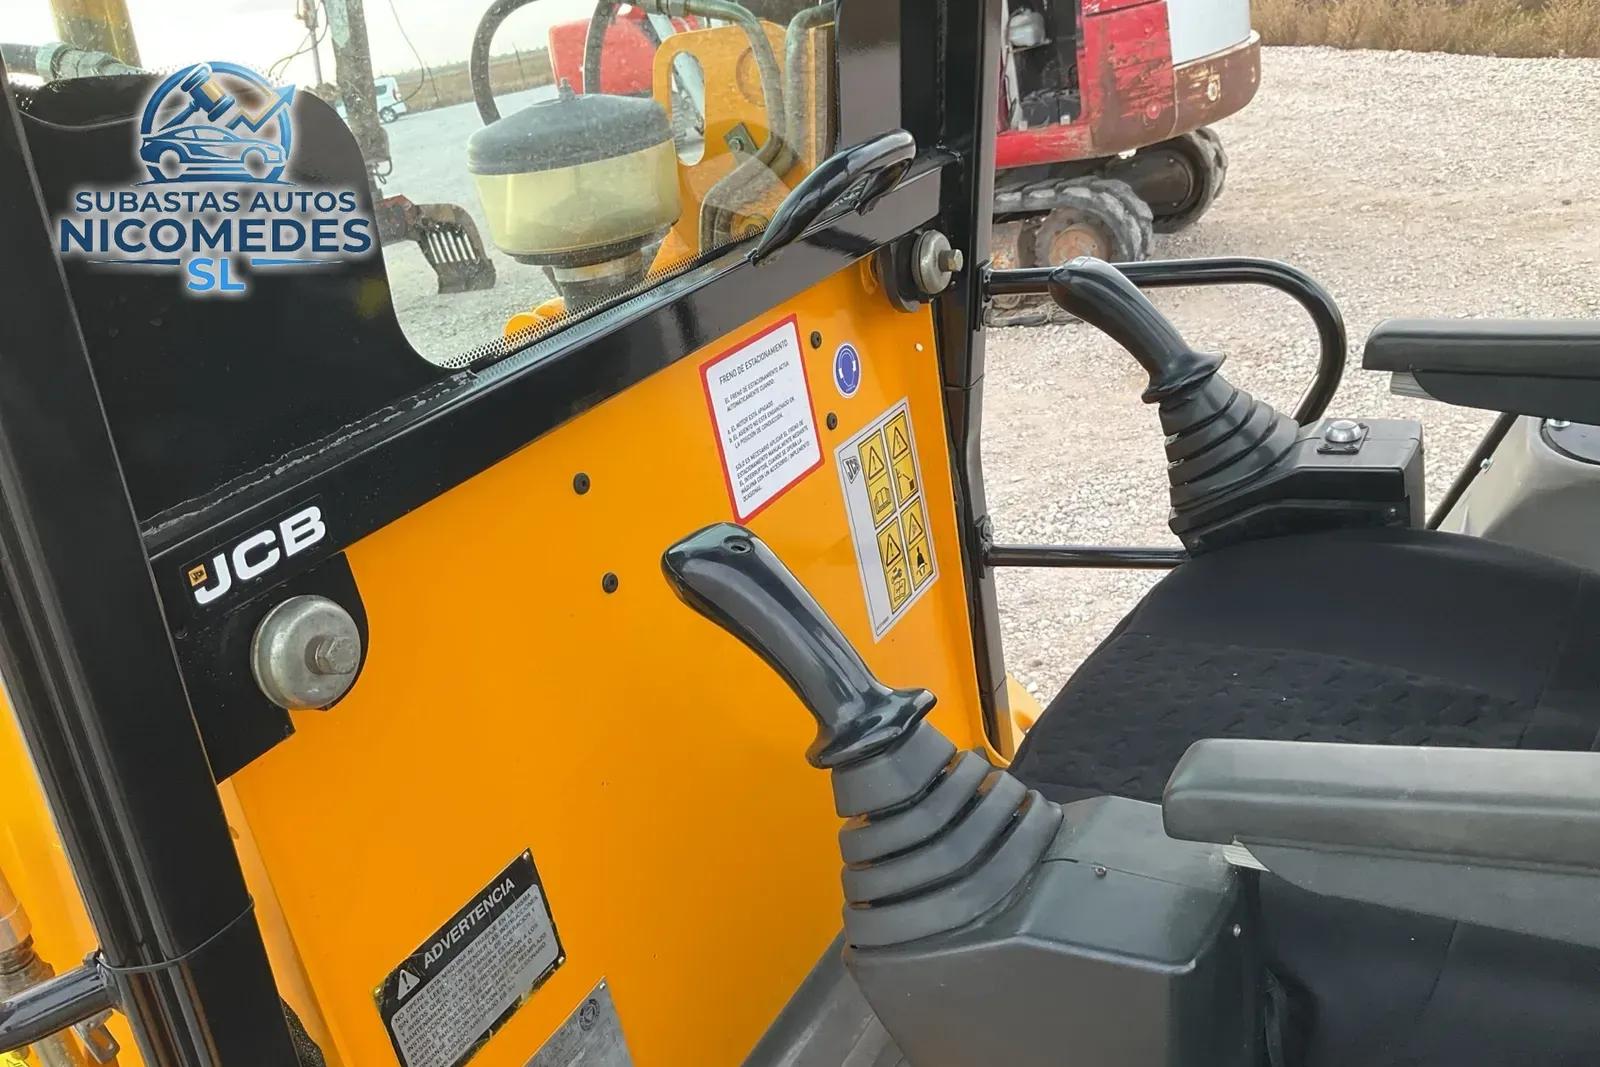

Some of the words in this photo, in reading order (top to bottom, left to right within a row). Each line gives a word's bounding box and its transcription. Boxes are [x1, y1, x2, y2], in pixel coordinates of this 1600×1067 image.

[719, 369, 737, 385] FRENO
[737, 364, 745, 375] DE
[745, 339, 788, 370] ESTACIONAMIENTO
[730, 389, 742, 400] FRENO
[748, 367, 778, 390] ESTACIONAMIENTO
[736, 417, 748, 428] MOTOR
[739, 424, 753, 437] ASIENTO
[737, 453, 768, 479] ESTACIONAMIENTO
[768, 436, 792, 456] MANUALMENTE
[750, 443, 769, 460] NECESARIO
[770, 434, 783, 446] APLICAR
[788, 423, 799, 432] FRENO
[768, 452, 781, 465] CUANDO
[787, 442, 797, 452] OPERA
[844, 459, 860, 480] JCB
[194, 506, 326, 605] JCB
[425, 878, 515, 969] ADVERTENCIA
[395, 1012, 404, 1023] NO
[406, 993, 424, 1013] OPERE
[426, 979, 441, 994] ESTA
[498, 917, 506, 926] EN
[507, 909, 514, 918] LA
[514, 893, 531, 910] MISMA
[398, 1018, 409, 1030] SIN
[410, 1000, 429, 1020] ANTES
[429, 984, 445, 1000] LEER
[451, 943, 487, 980] COMPRENDER
[488, 933, 499, 945] LAS
[499, 895, 538, 934] INSTRUCCIONES
[458, 982, 467, 993] NO
[469, 974, 476, 983] SE
[477, 953, 497, 975] SIGUEN
[498, 937, 513, 955] ESTAS
[491, 968, 502, 980] SER
[407, 1007, 452, 1053] INSTRUCCIONES
[459, 992, 468, 1002] NO
[469, 983, 476, 992] SE
[478, 964, 497, 984] PRESTA
[528, 923, 538, 935] LOS
[408, 1010, 428, 1031] AVISOS
[429, 997, 442, 1011] QUE
[454, 977, 463, 987] EN
[464, 970, 471, 978] EL
[472, 949, 494, 970] MANUAL
[494, 940, 501, 949] DE
[486, 991, 498, 1004] CON
[438, 1026, 453, 1042] PARA
[444, 1030, 469, 1056] CUIDADO
